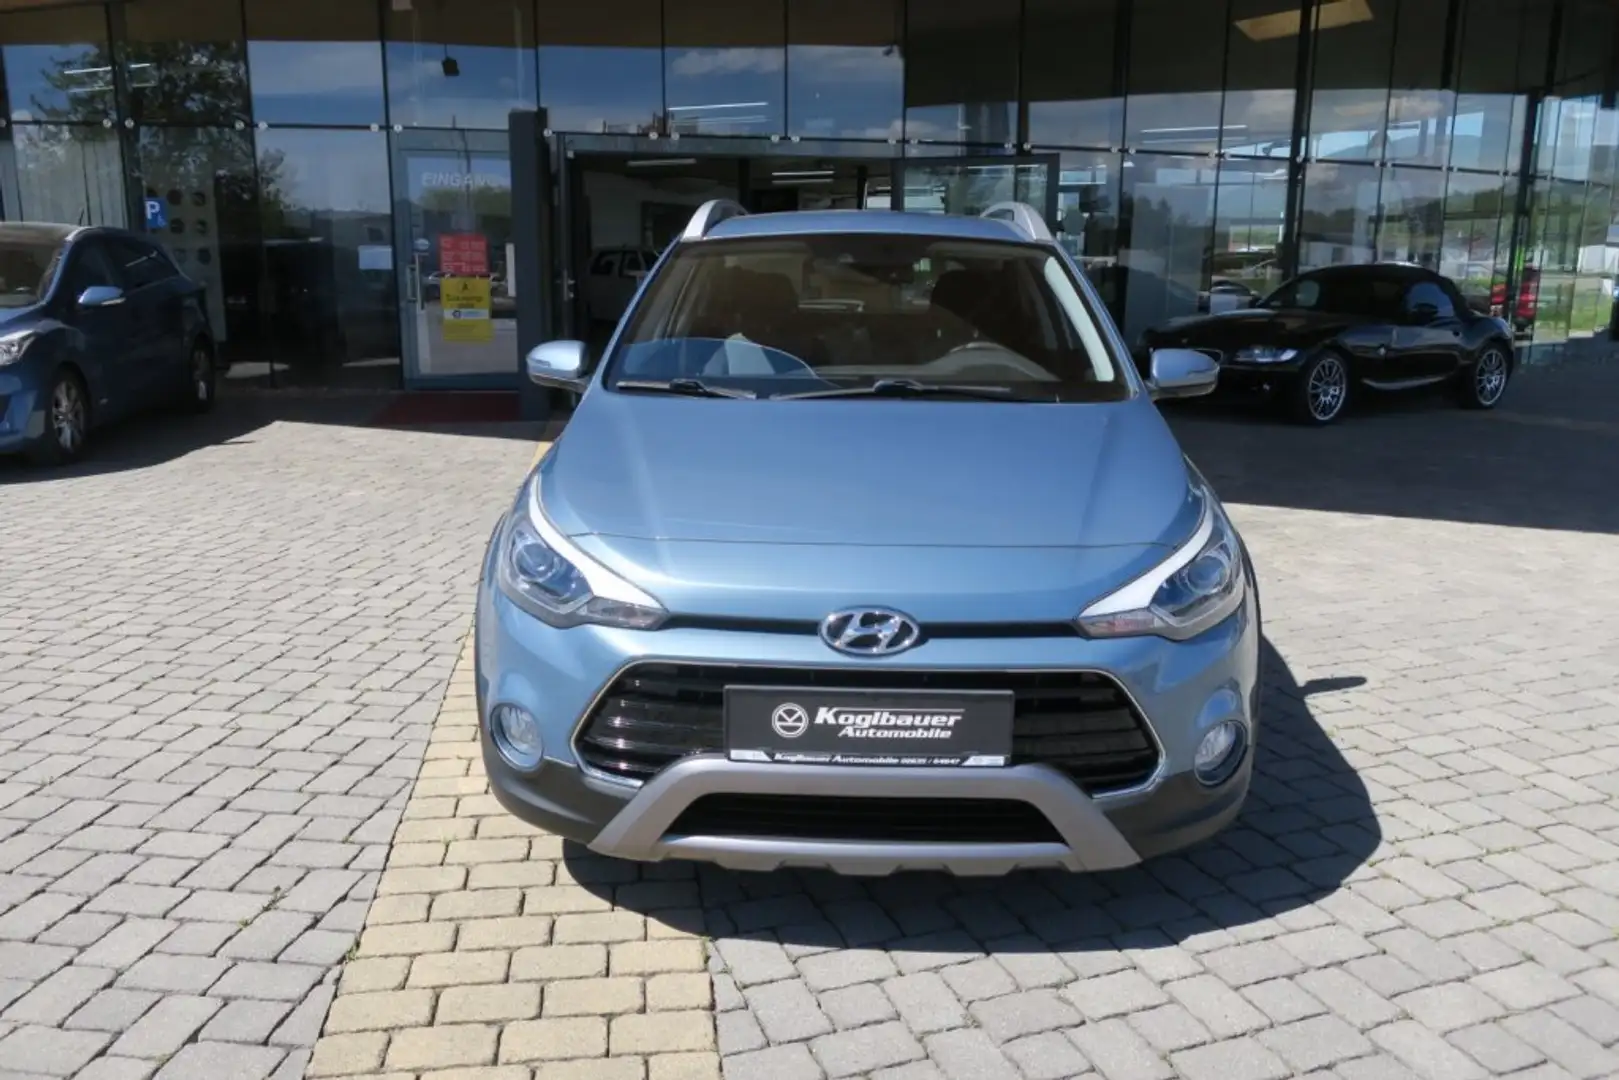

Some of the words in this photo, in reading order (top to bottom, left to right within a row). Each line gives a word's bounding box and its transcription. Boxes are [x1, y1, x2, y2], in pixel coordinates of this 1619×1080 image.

[145, 201, 160, 220] P
[814, 706, 962, 729] Koglbauer
[837, 727, 953, 739] Automobile
